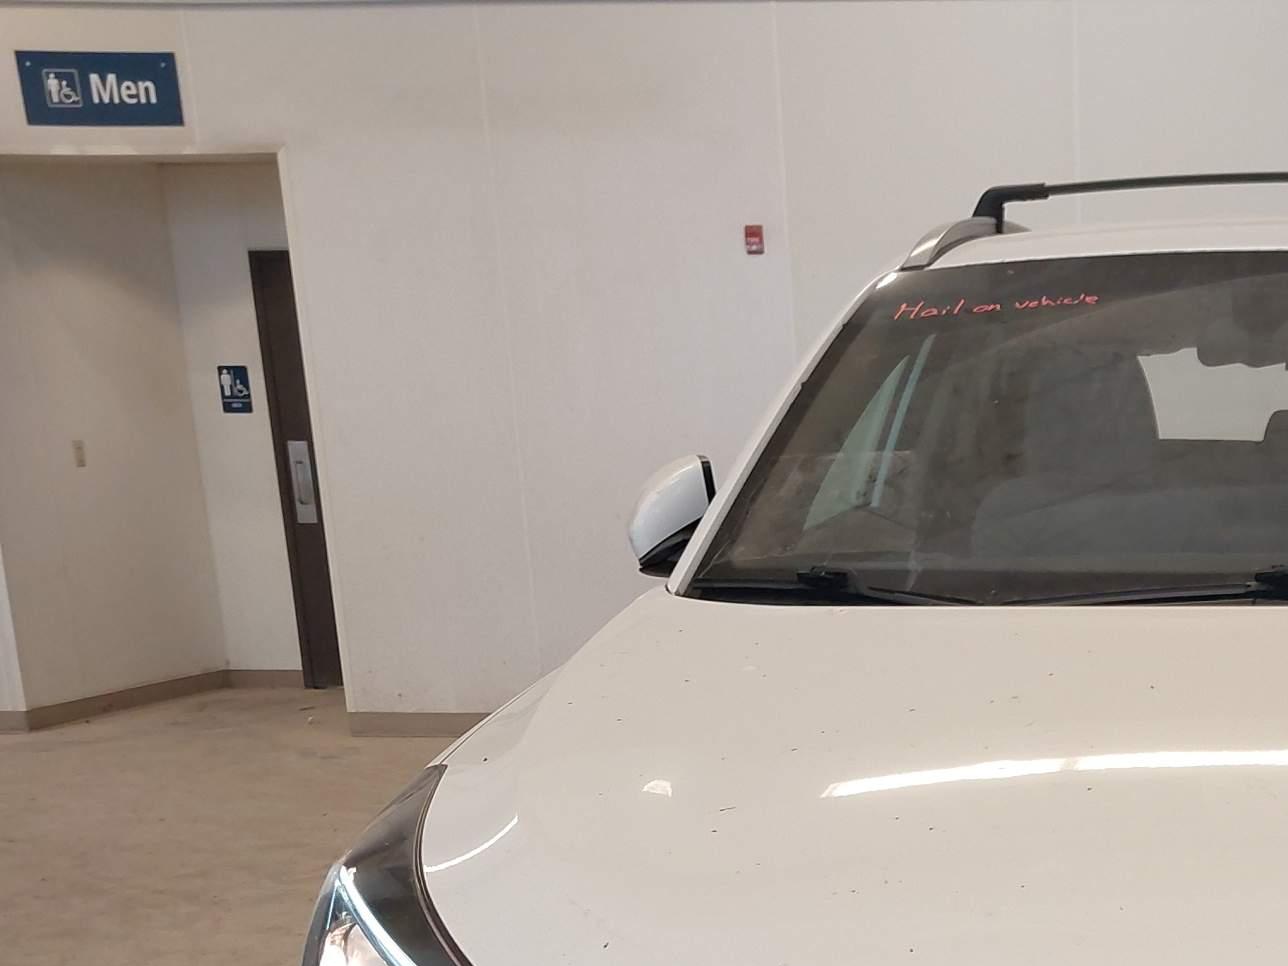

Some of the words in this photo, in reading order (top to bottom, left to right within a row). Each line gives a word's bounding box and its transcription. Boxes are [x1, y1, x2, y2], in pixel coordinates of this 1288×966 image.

[89, 72, 157, 105] Men
[893, 299, 966, 320] Hail
[972, 302, 1001, 314] on
[1015, 292, 1100, 310] vehicle
